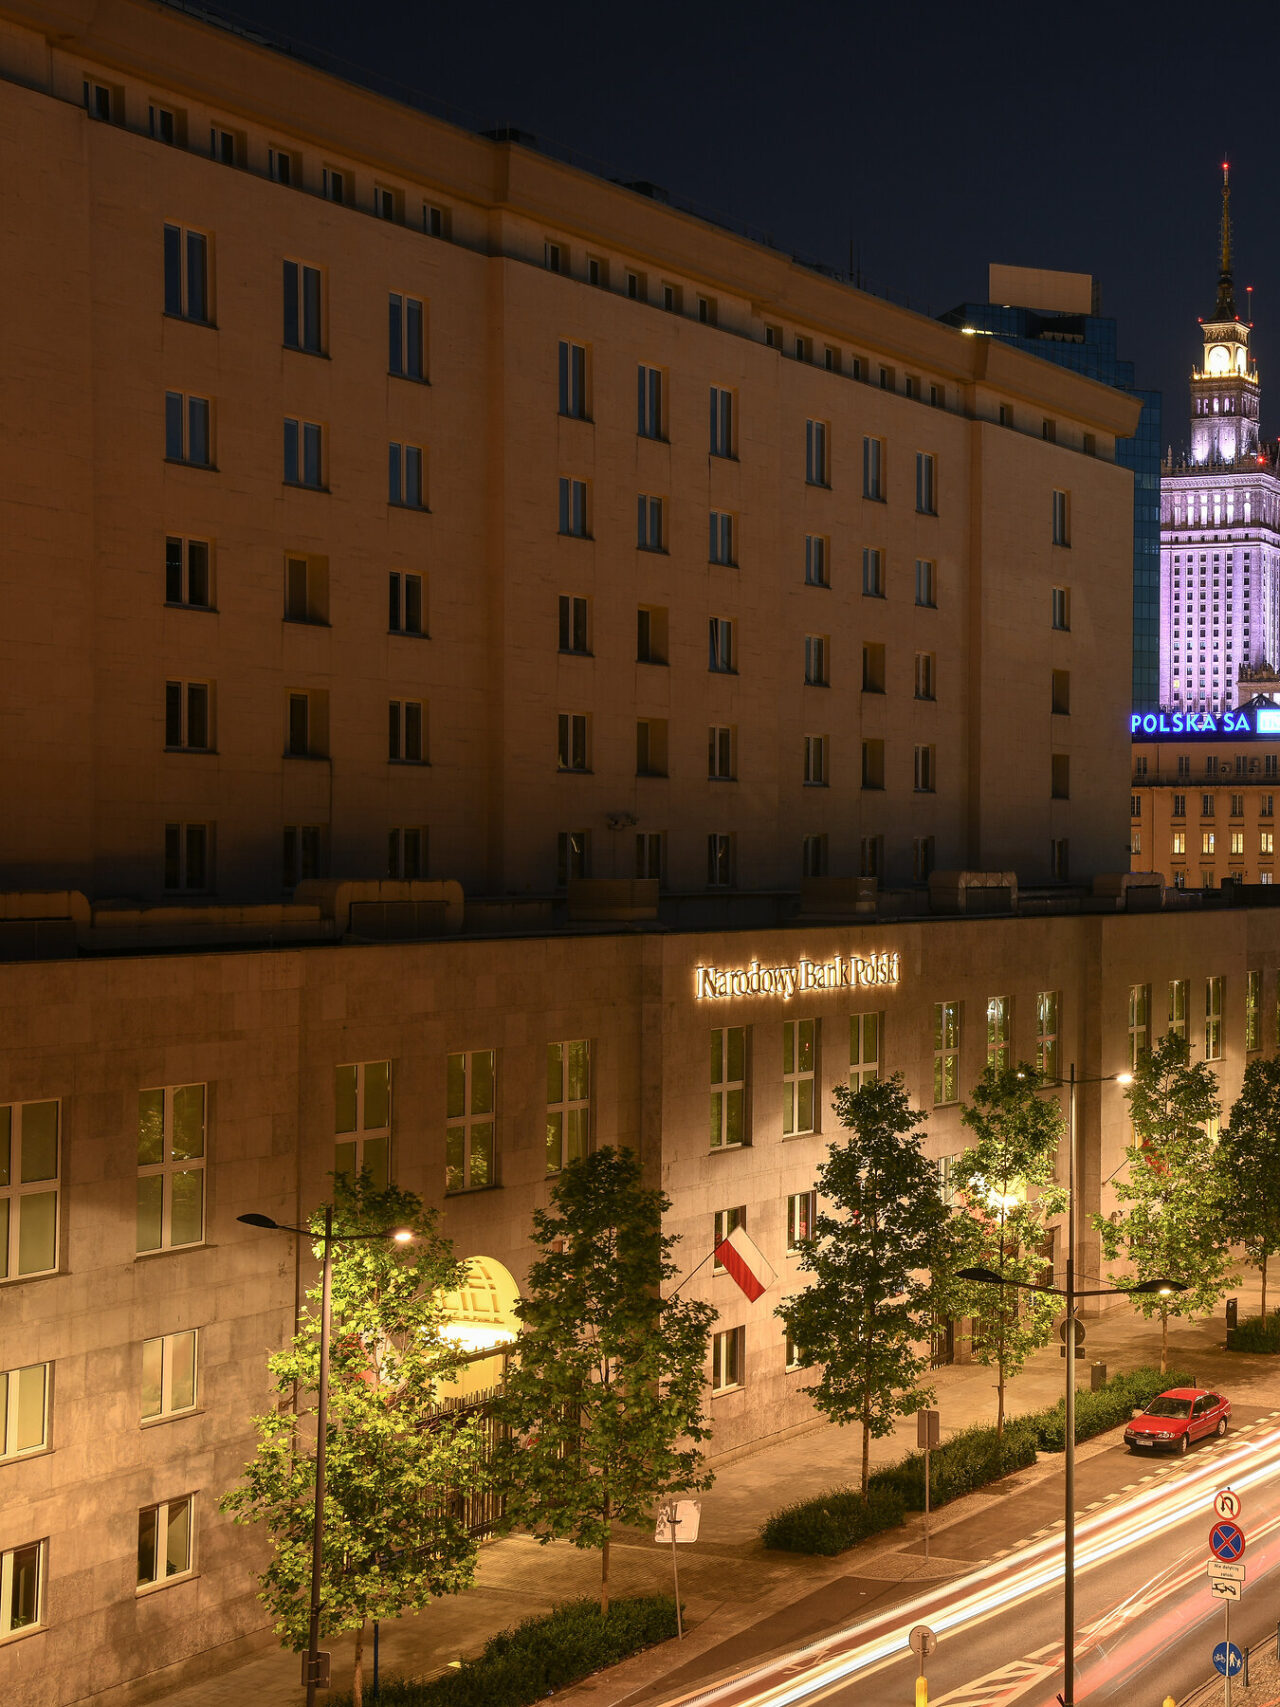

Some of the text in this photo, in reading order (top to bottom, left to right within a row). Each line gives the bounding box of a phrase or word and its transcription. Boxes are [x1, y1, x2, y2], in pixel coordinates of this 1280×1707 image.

[1131, 713, 1250, 732] POLSKA SA
[695, 952, 901, 1000] Narodowy Bank Polski
